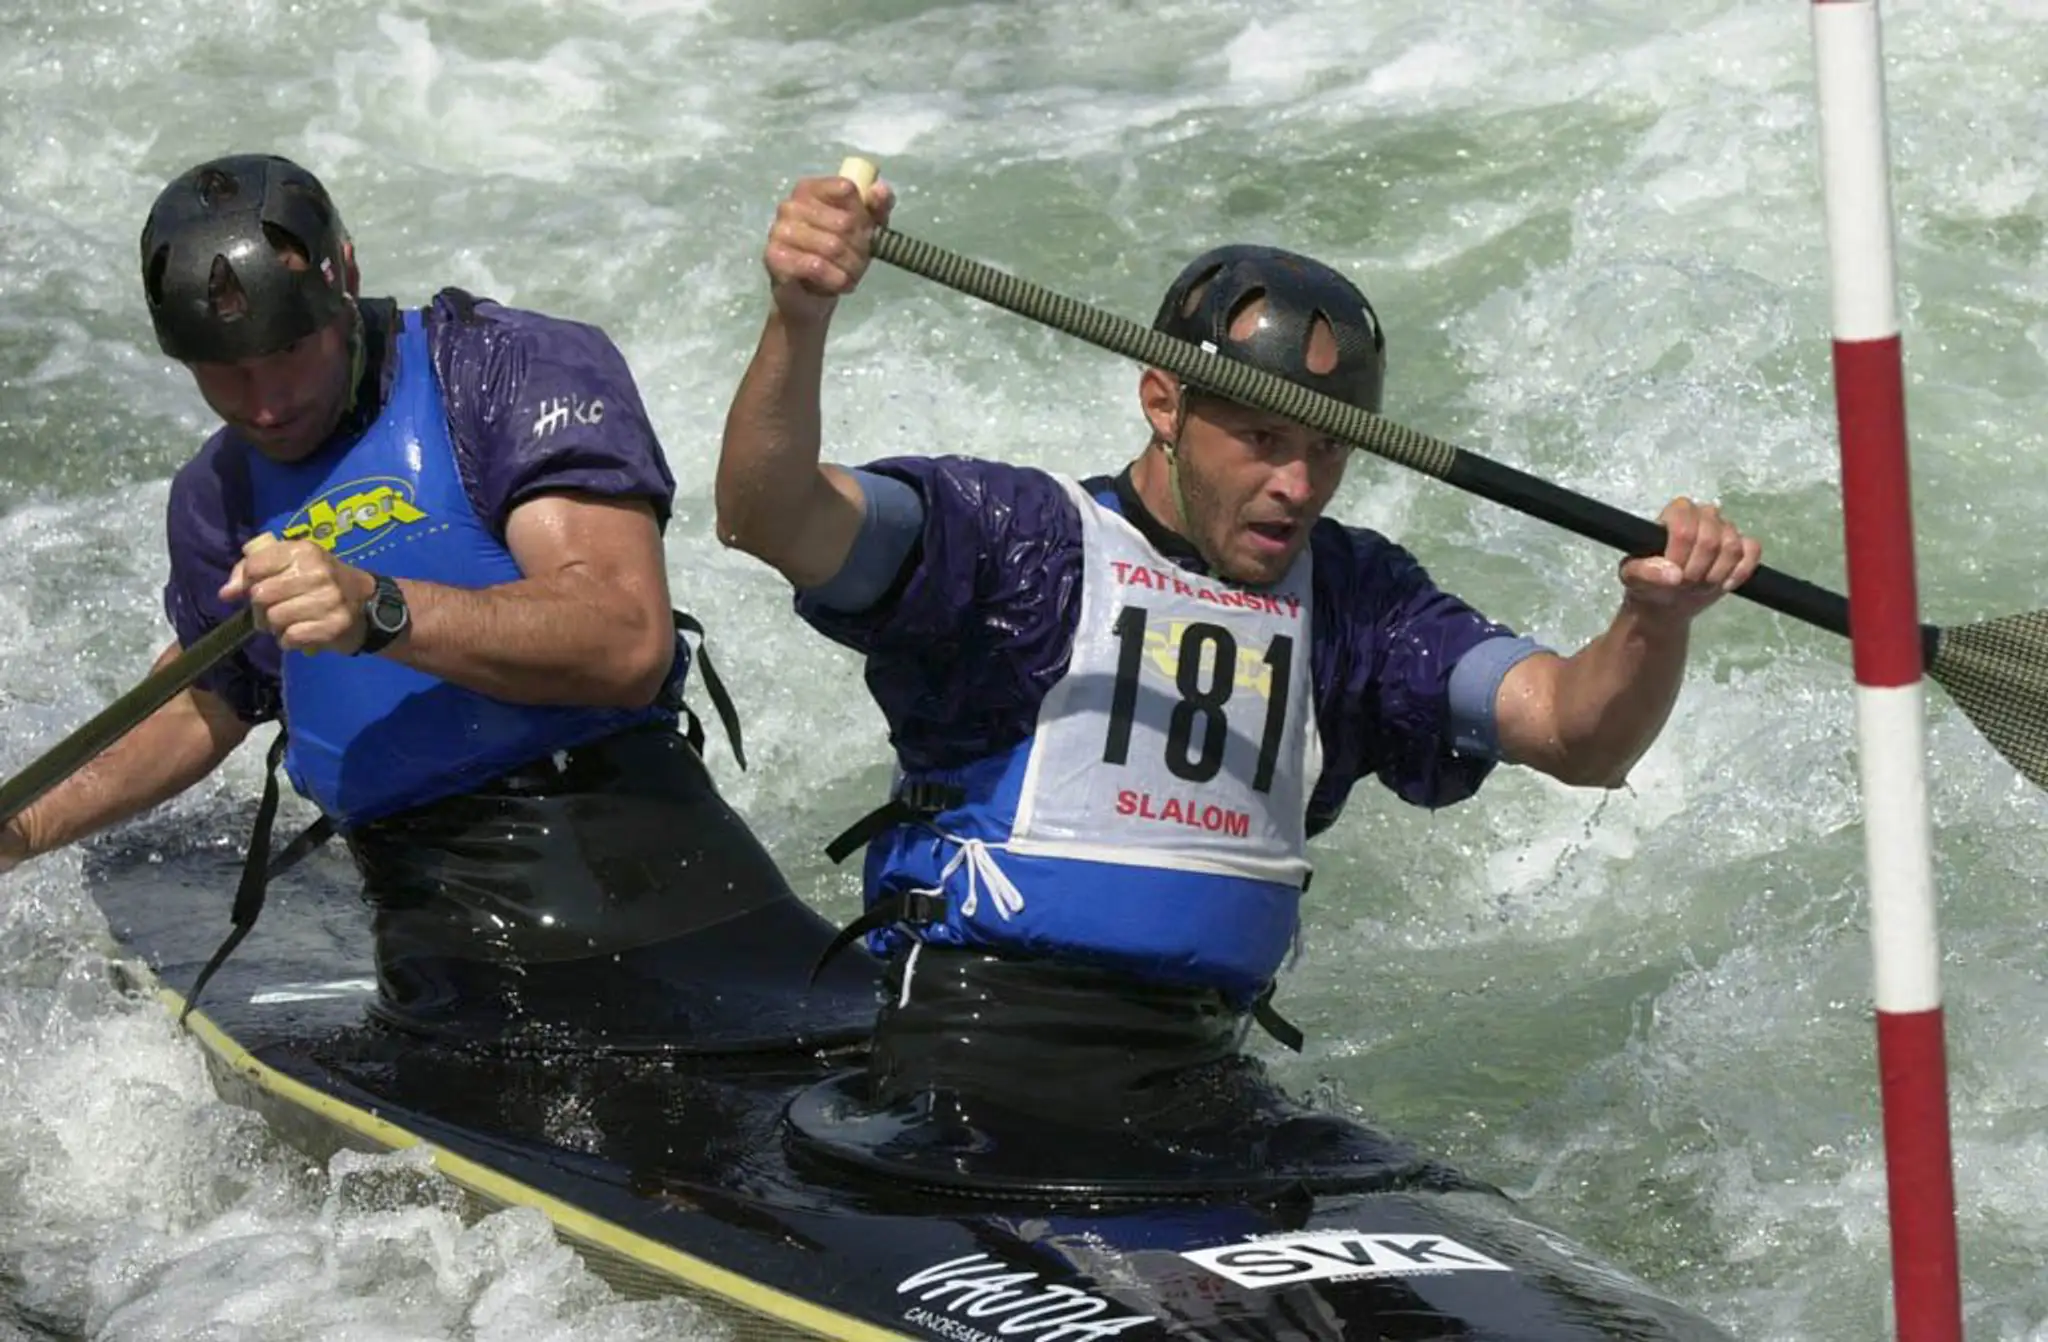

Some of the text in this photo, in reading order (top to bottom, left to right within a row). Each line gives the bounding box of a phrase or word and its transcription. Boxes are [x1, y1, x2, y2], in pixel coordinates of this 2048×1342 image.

[1102, 605, 1293, 794] 181
[1116, 790, 1250, 838] SLALOM
[1215, 1239, 1488, 1277] SVK
